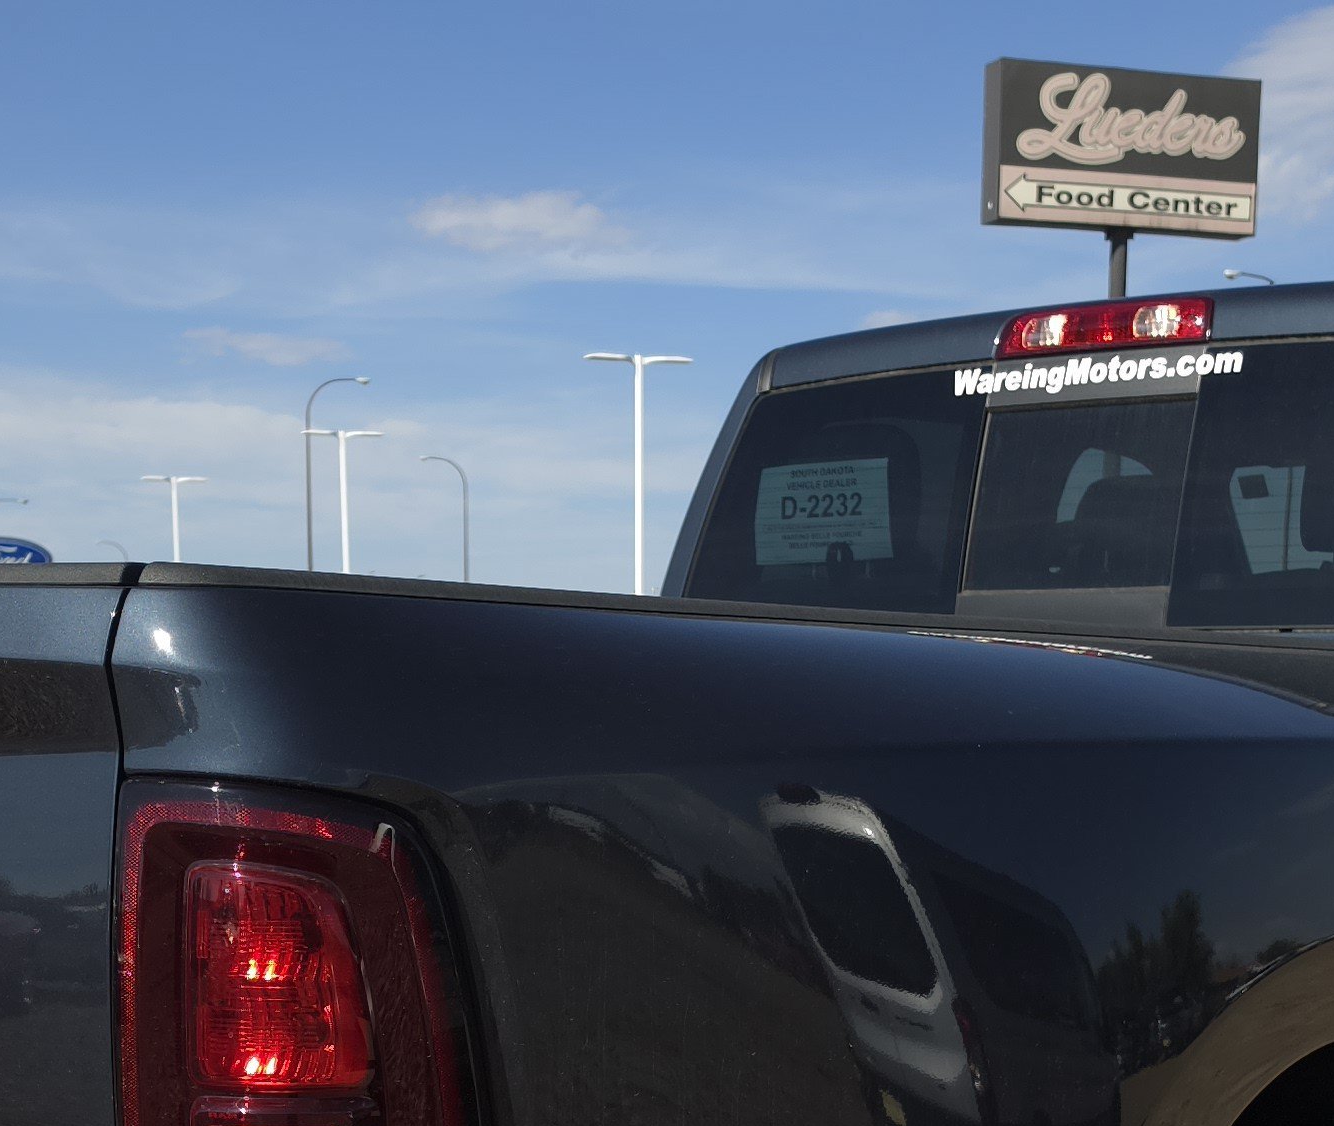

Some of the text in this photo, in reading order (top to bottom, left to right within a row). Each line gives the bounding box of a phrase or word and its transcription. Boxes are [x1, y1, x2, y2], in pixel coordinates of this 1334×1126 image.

[1017, 72, 1246, 165] Lueders
[1035, 184, 1238, 216] Food Center
[954, 351, 1244, 396] WareingMotors.com
[787, 478, 857, 491] VEHICLE DEALER
[790, 466, 855, 479] SOUTH DAKOTA
[781, 492, 862, 519] D-2232
